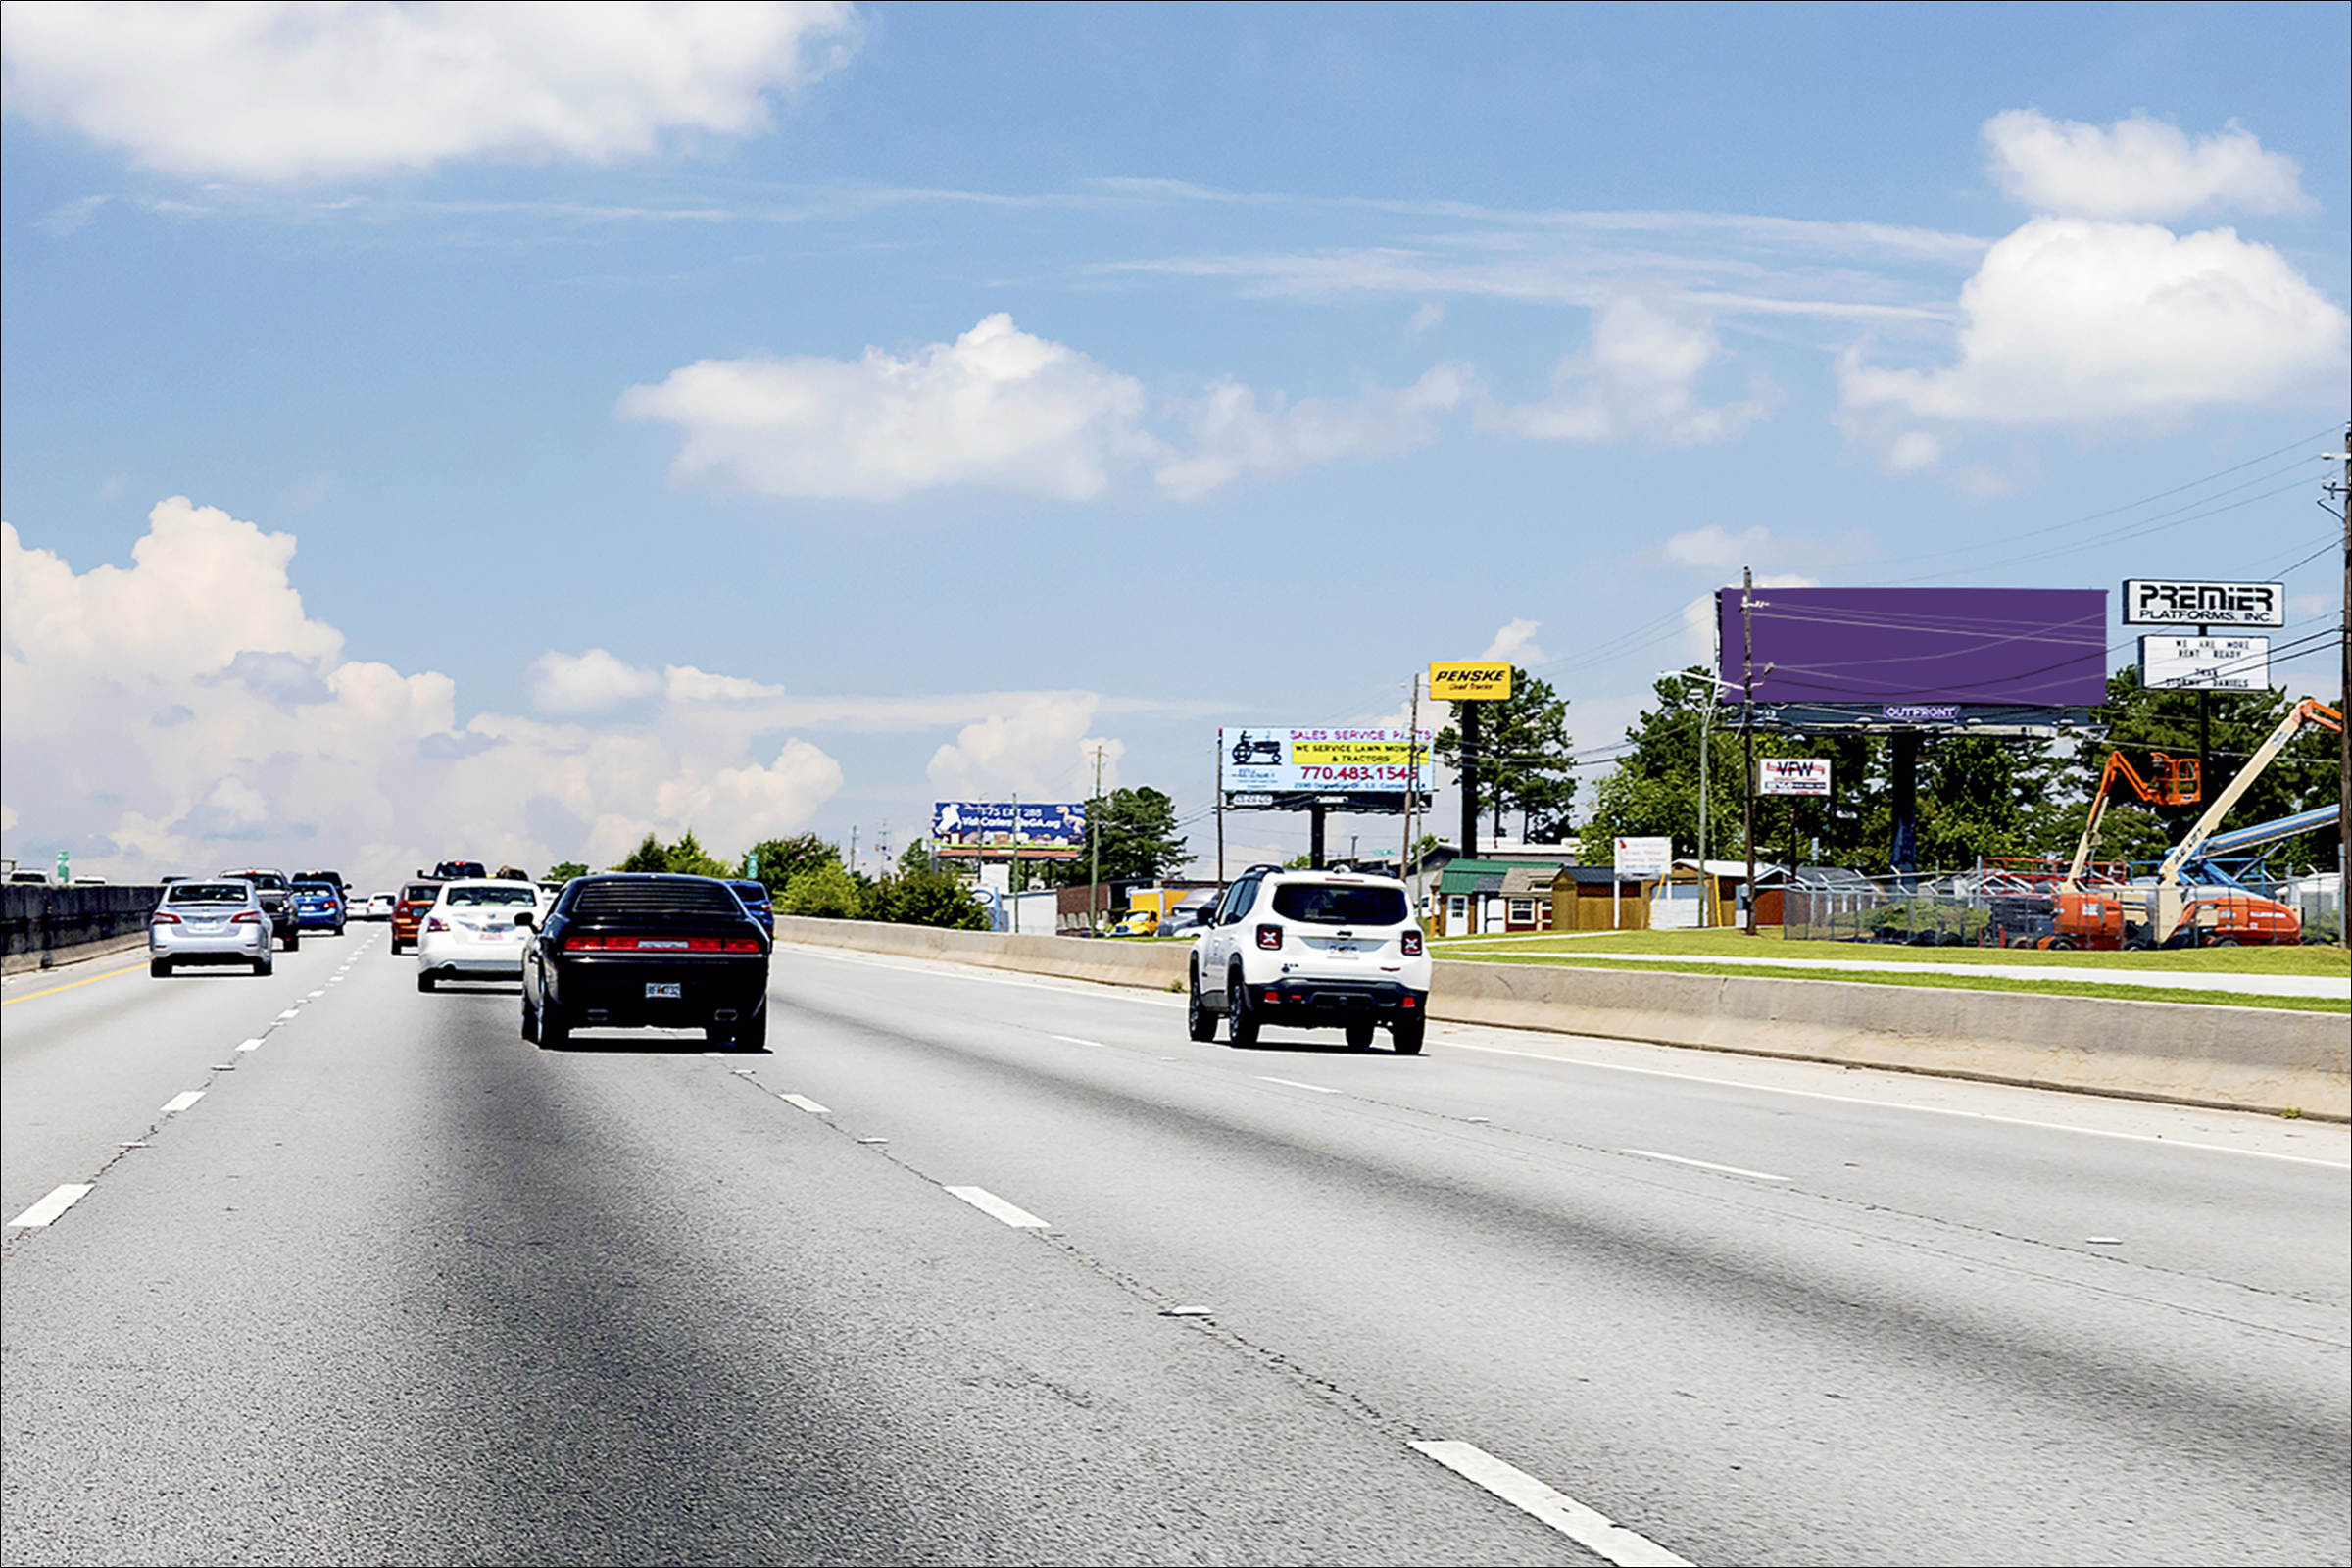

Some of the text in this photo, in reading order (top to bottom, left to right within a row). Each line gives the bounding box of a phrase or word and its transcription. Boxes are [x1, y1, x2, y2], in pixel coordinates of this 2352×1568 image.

[2139, 584, 2274, 612] PREMIER
[2244, 612, 2275, 622] INC.
[1435, 670, 1506, 682] PENSKE
[1886, 707, 1956, 717] OUTFRONT
[1290, 730, 1432, 741] SALES SERVICE PATS
[1777, 761, 1814, 776] VFW
[1002, 808, 1021, 817] EXT
